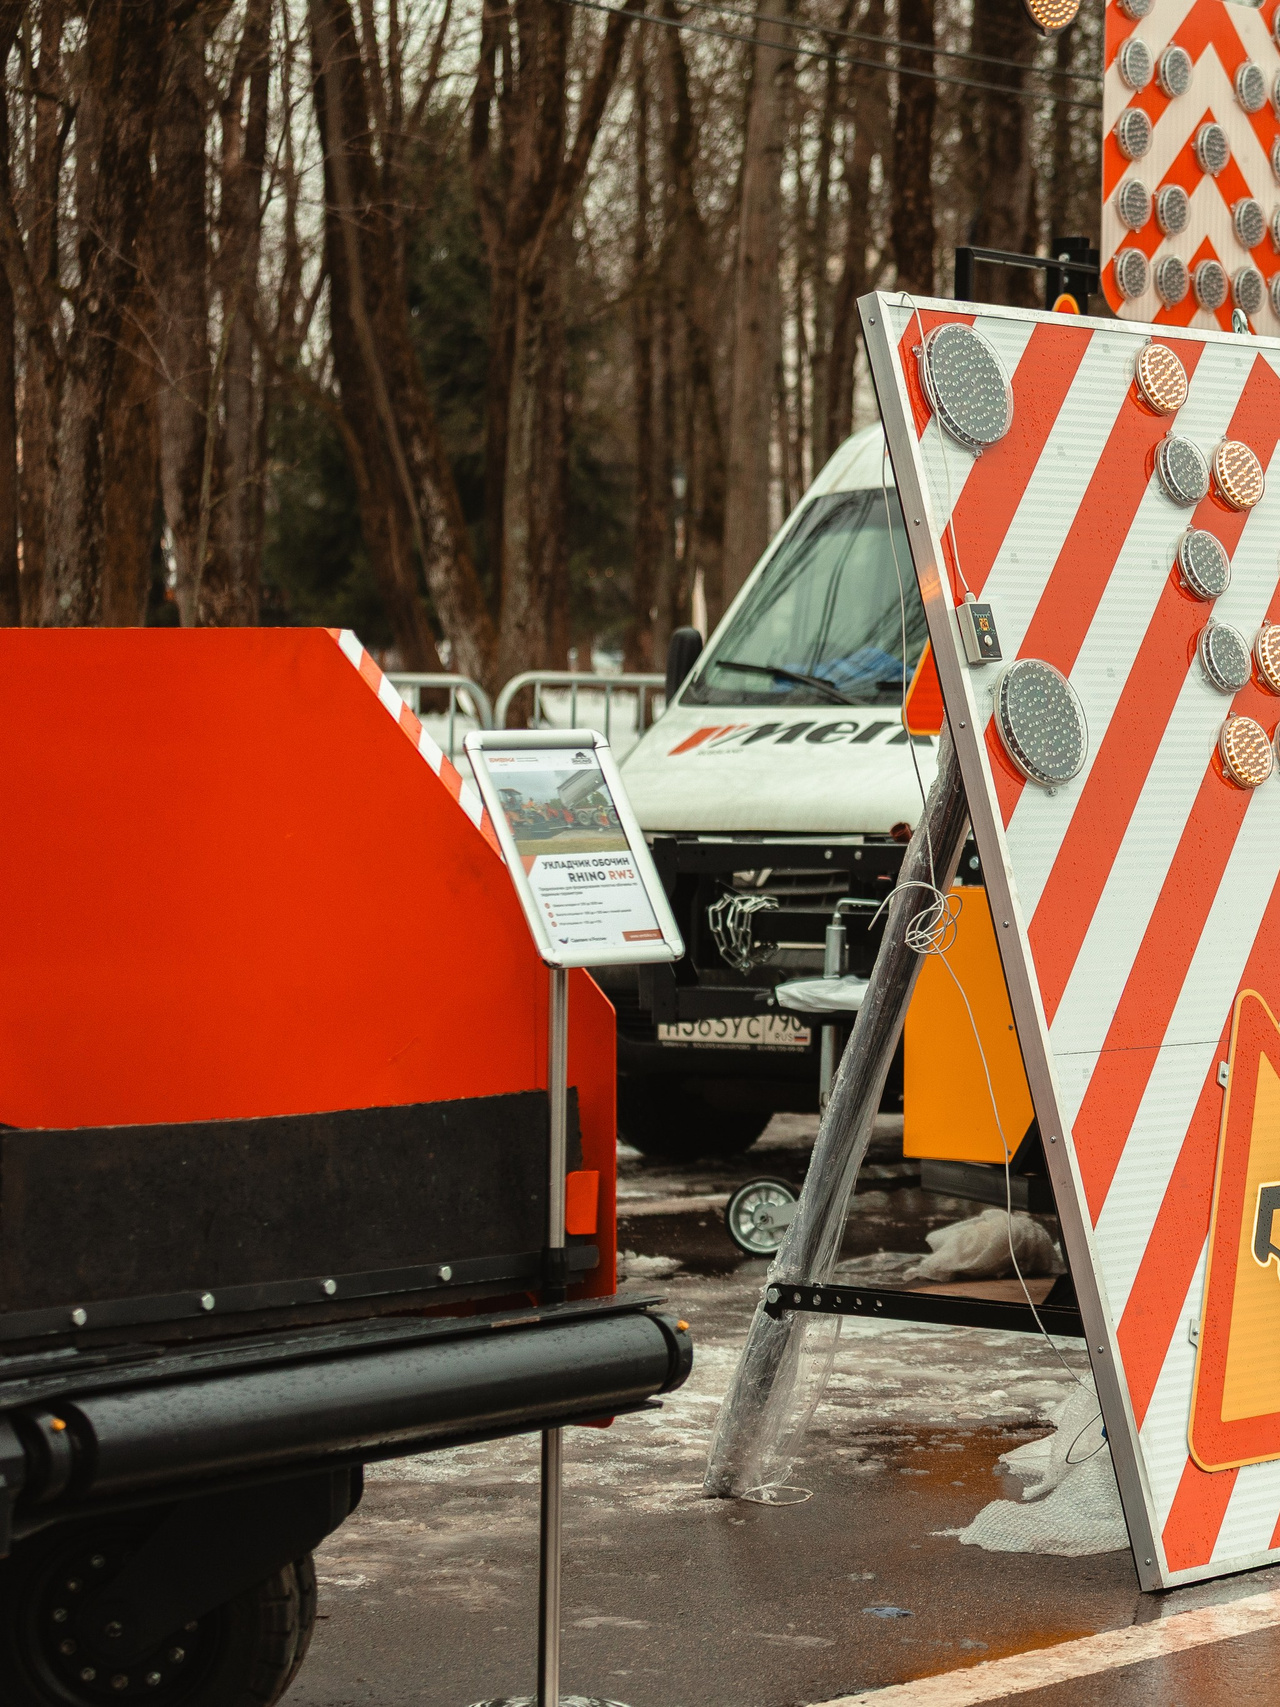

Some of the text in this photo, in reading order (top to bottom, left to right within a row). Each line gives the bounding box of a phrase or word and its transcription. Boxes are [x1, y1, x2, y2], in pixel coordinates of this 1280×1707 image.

[542, 857, 630, 870] УКЛАДЧИК ОБОЧИН
[568, 869, 635, 882] RHINO RW3
